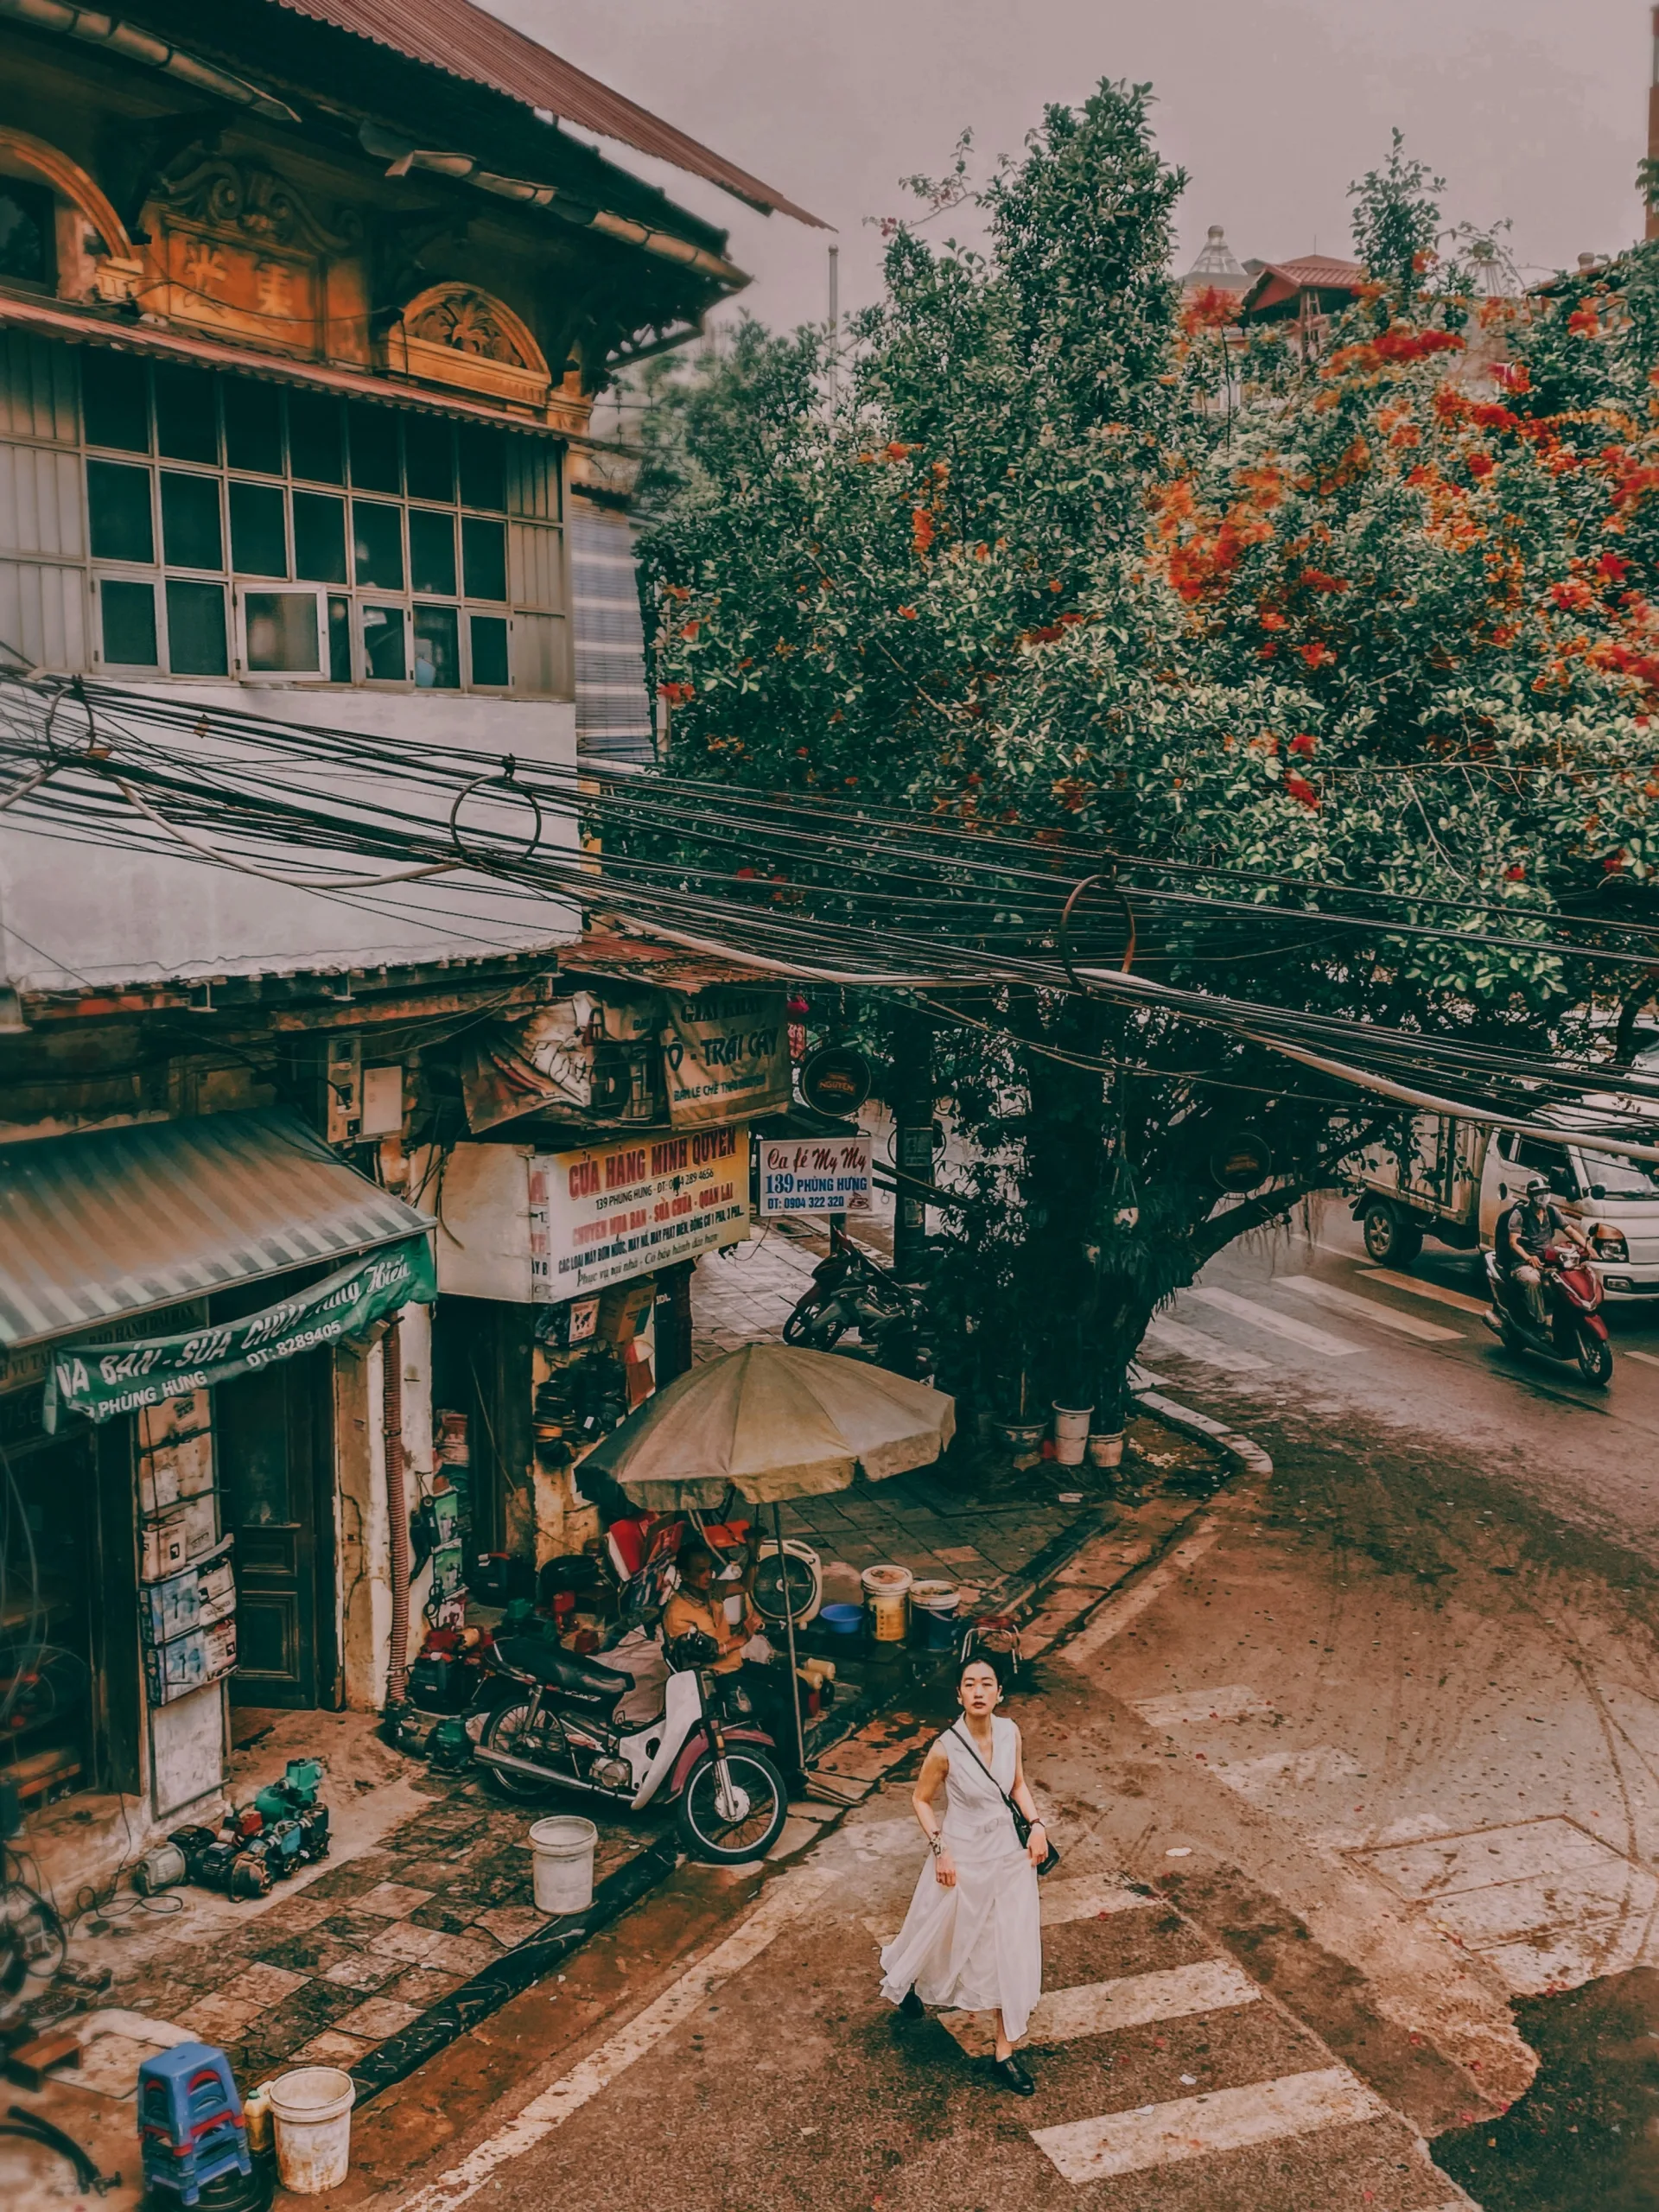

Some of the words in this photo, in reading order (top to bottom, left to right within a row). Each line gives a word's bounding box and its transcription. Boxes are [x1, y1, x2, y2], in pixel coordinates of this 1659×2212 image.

[569, 1149, 601, 1198] CỬA
[651, 1136, 688, 1178] MINH
[767, 1148, 788, 1170] Ca
[793, 1147, 809, 1173] fé
[812, 1147, 837, 1174] My
[841, 1147, 866, 1174] My
[766, 1173, 794, 1193] 139
[595, 1198, 608, 1210] 139
[784, 1197, 805, 1209] 0904
[809, 1196, 825, 1208] 322
[827, 1196, 844, 1207] 320
[98, 1386, 156, 1417] PHÙNG
[275, 1319, 342, 1357] 8289405
